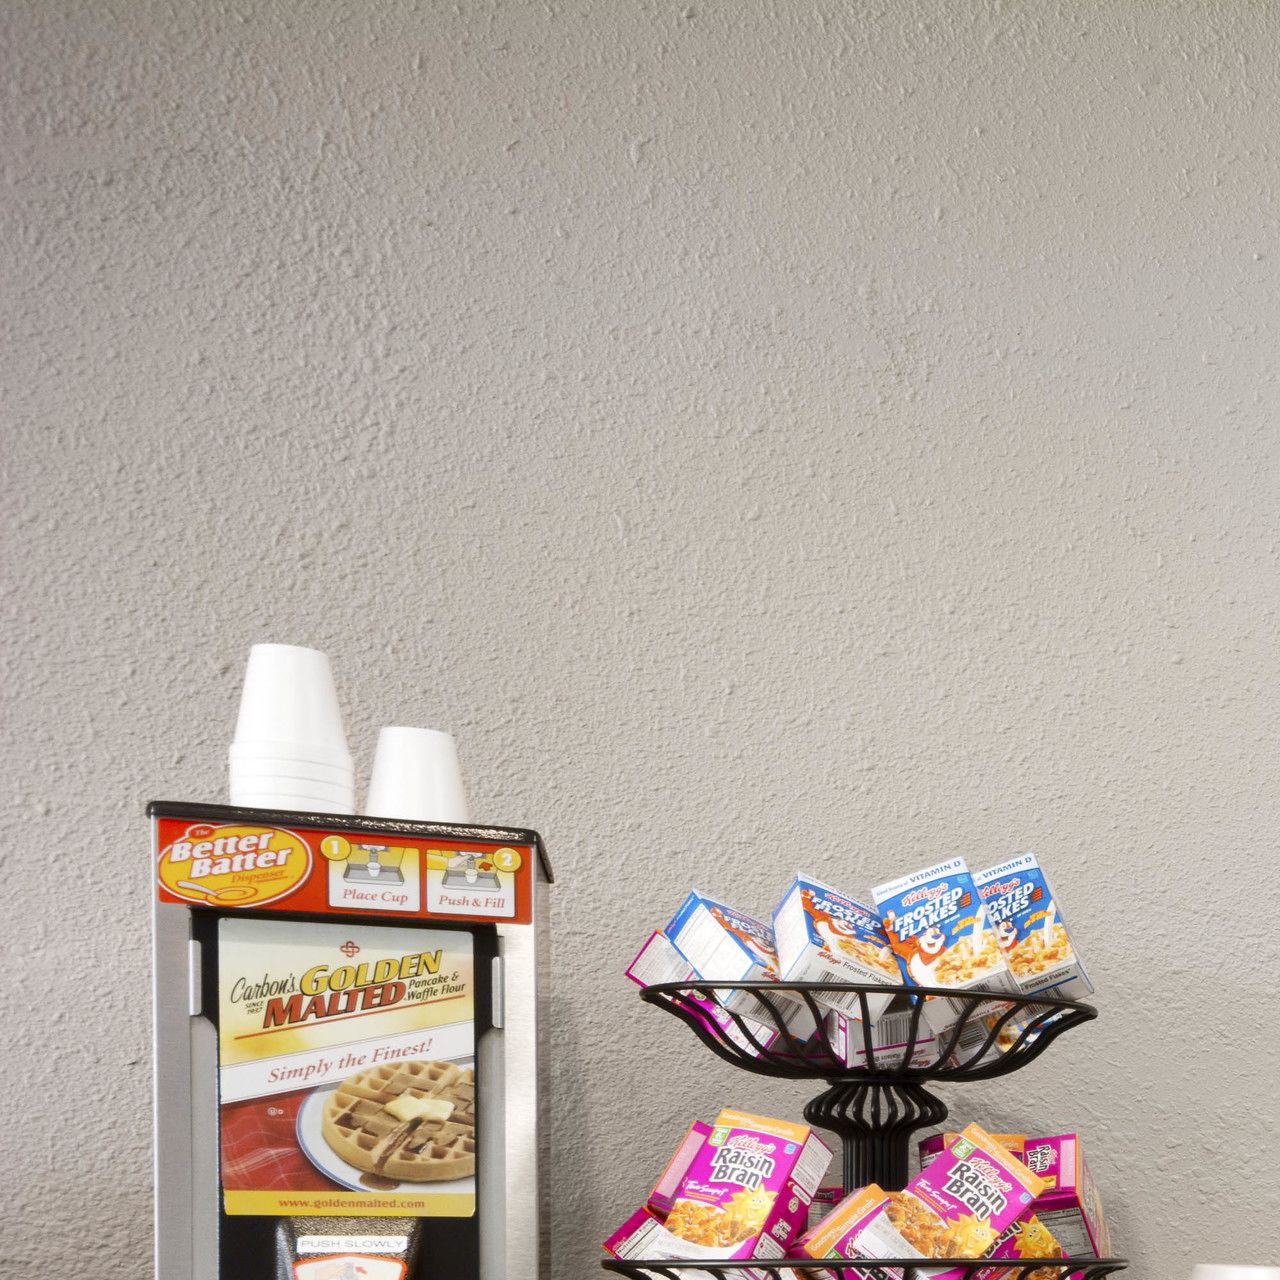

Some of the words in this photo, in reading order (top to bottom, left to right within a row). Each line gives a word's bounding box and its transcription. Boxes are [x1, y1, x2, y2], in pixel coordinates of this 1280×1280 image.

[169, 831, 275, 863] Better
[331, 840, 339, 855] 1
[189, 848, 293, 879] Batter
[501, 853, 513, 867] 2
[983, 860, 1023, 878] VITAMIN
[231, 870, 285, 884] Dispenser
[909, 863, 952, 883] VITAMIN
[342, 888, 378, 902] Place
[381, 891, 409, 906] Cup
[438, 895, 470, 907] Push
[472, 898, 481, 907] &
[484, 898, 505, 908] Fill
[902, 883, 948, 907] Kellogg's
[988, 882, 1034, 914] OSTED
[894, 887, 963, 933] FROSTED
[900, 901, 958, 942] FLAKES
[992, 896, 1030, 922] AKES
[300, 949, 444, 997] GOLDEN
[408, 975, 450, 989] Pancake
[451, 971, 459, 981] &
[843, 962, 869, 978] Frosted
[230, 973, 296, 1004] Carbon's
[406, 987, 440, 1002] Waffle
[441, 983, 467, 996] Flour
[1024, 977, 1049, 990] Frosted
[245, 1000, 264, 1009] SINCE
[263, 981, 407, 1029] MALTED
[268, 1060, 333, 1083] Simply
[338, 1053, 367, 1068] the
[371, 1039, 434, 1063] Finest!
[726, 1134, 777, 1155] Kellogg's
[712, 1147, 775, 1177] Raisin
[1038, 1144, 1051, 1172] Raisin
[712, 1164, 762, 1190] Bran
[950, 1162, 1006, 1211] Raisin
[968, 1157, 1013, 1192] Kellogg's
[279, 1198, 425, 1210] www.goldenmalted.com
[946, 1178, 991, 1220] Bran
[300, 1240, 341, 1248] PUSH
[344, 1239, 403, 1249] SLOWLY
